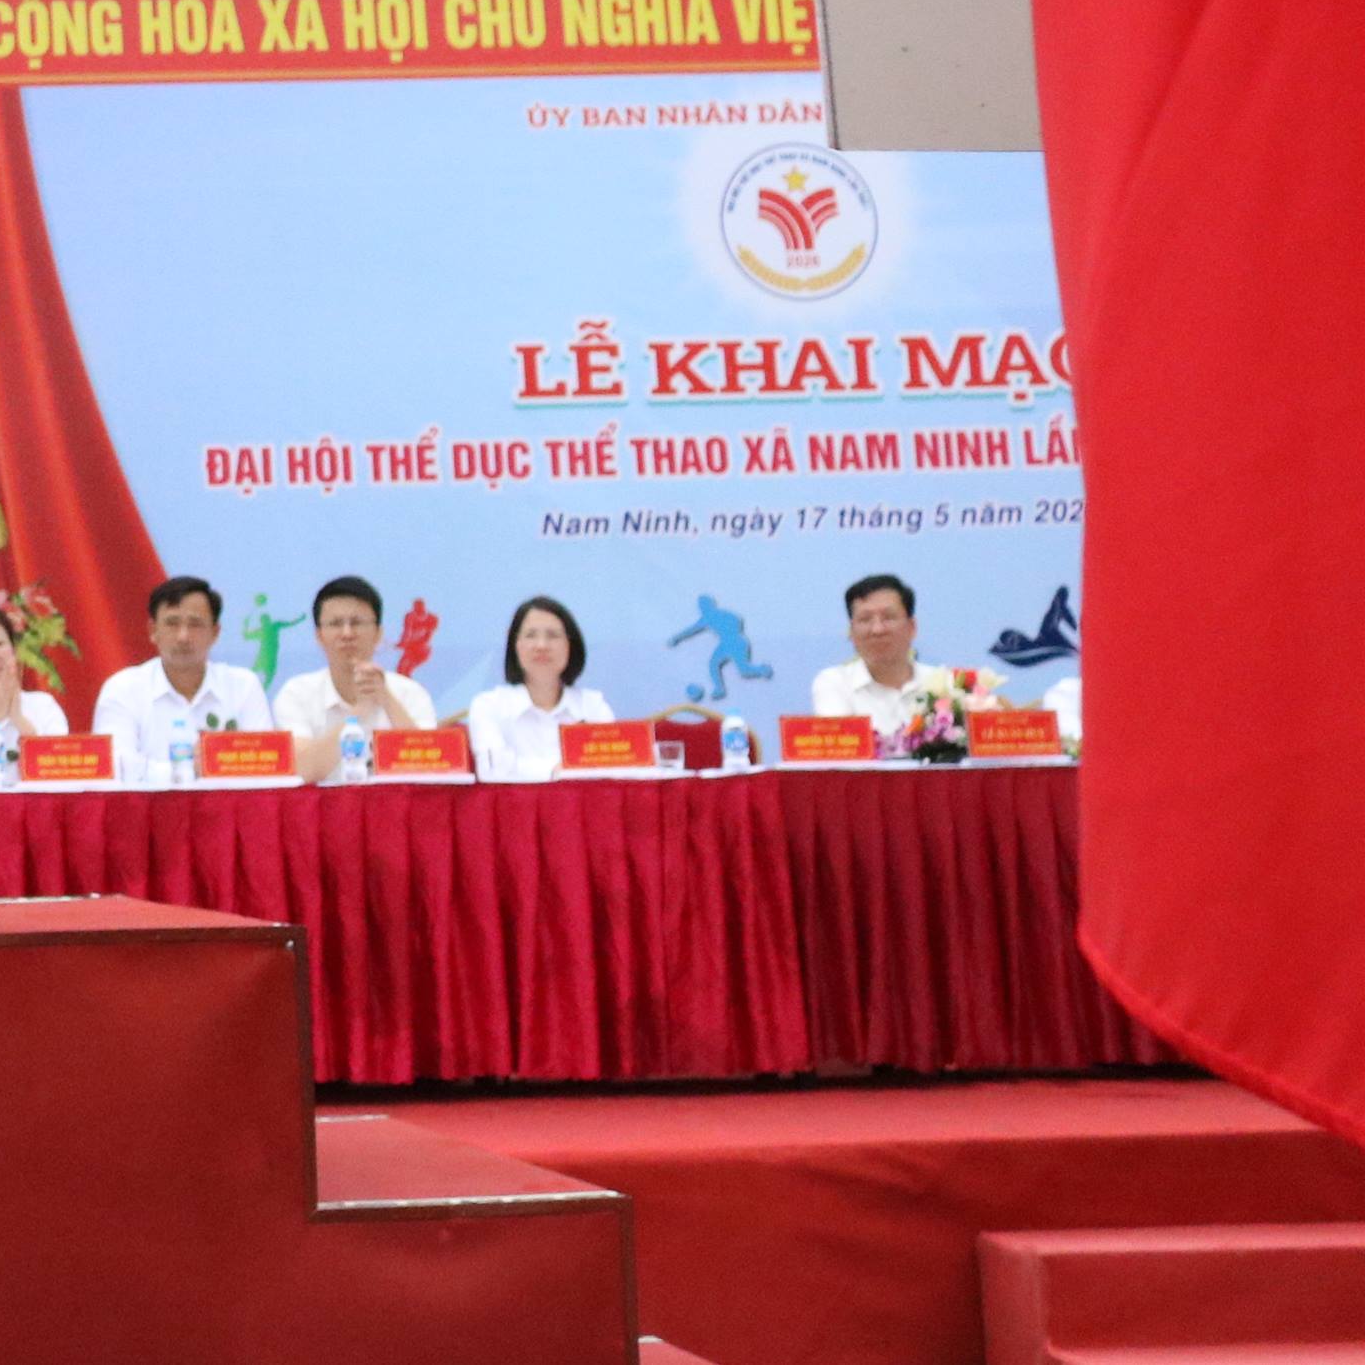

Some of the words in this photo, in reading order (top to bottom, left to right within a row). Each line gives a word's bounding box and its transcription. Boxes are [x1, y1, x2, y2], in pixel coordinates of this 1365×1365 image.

[526, 102, 571, 128] ỦY
[581, 105, 647, 127] BAN
[656, 100, 748, 125] NHÂN
[757, 99, 823, 123] DÂN
[515, 319, 625, 399] LỄ
[647, 337, 879, 395] KHAI
[206, 447, 271, 495] ĐẠI
[287, 436, 353, 491] HỘI
[366, 426, 439, 482] THỂ
[452, 441, 531, 489] DỤC
[545, 421, 618, 477] THỂ
[630, 437, 728, 475] THAO
[743, 426, 795, 473] XÃ
[808, 433, 901, 471] NAM
[914, 431, 1010, 468] NINH
[542, 511, 610, 535] Nam
[621, 509, 699, 535] Ninh,
[710, 505, 784, 537] ngày
[795, 505, 828, 530] 17
[838, 501, 925, 535] tháng
[934, 503, 951, 527] 5
[960, 501, 1024, 525] năm
